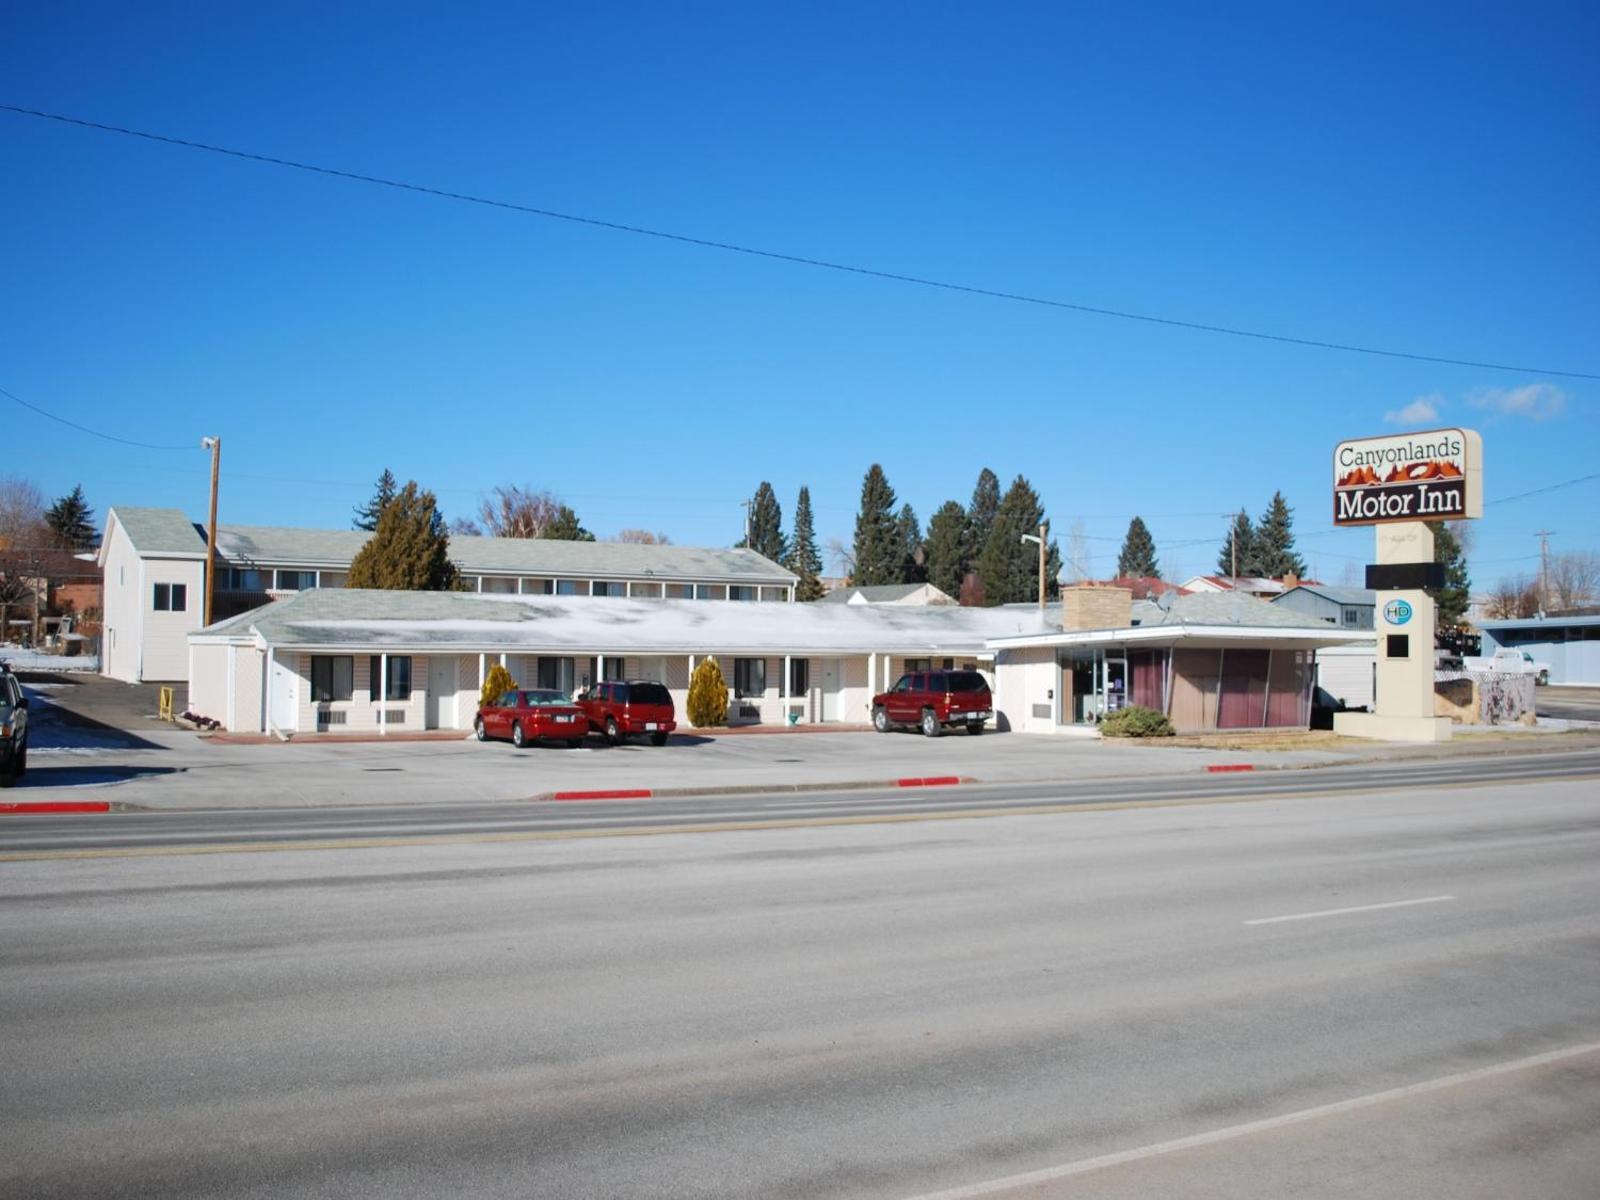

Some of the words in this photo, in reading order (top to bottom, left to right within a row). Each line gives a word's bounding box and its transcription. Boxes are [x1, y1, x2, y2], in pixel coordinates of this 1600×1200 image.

[1340, 437, 1461, 467] Canyonlands
[1338, 490, 1414, 519] Motor
[1417, 485, 1462, 513] Inn
